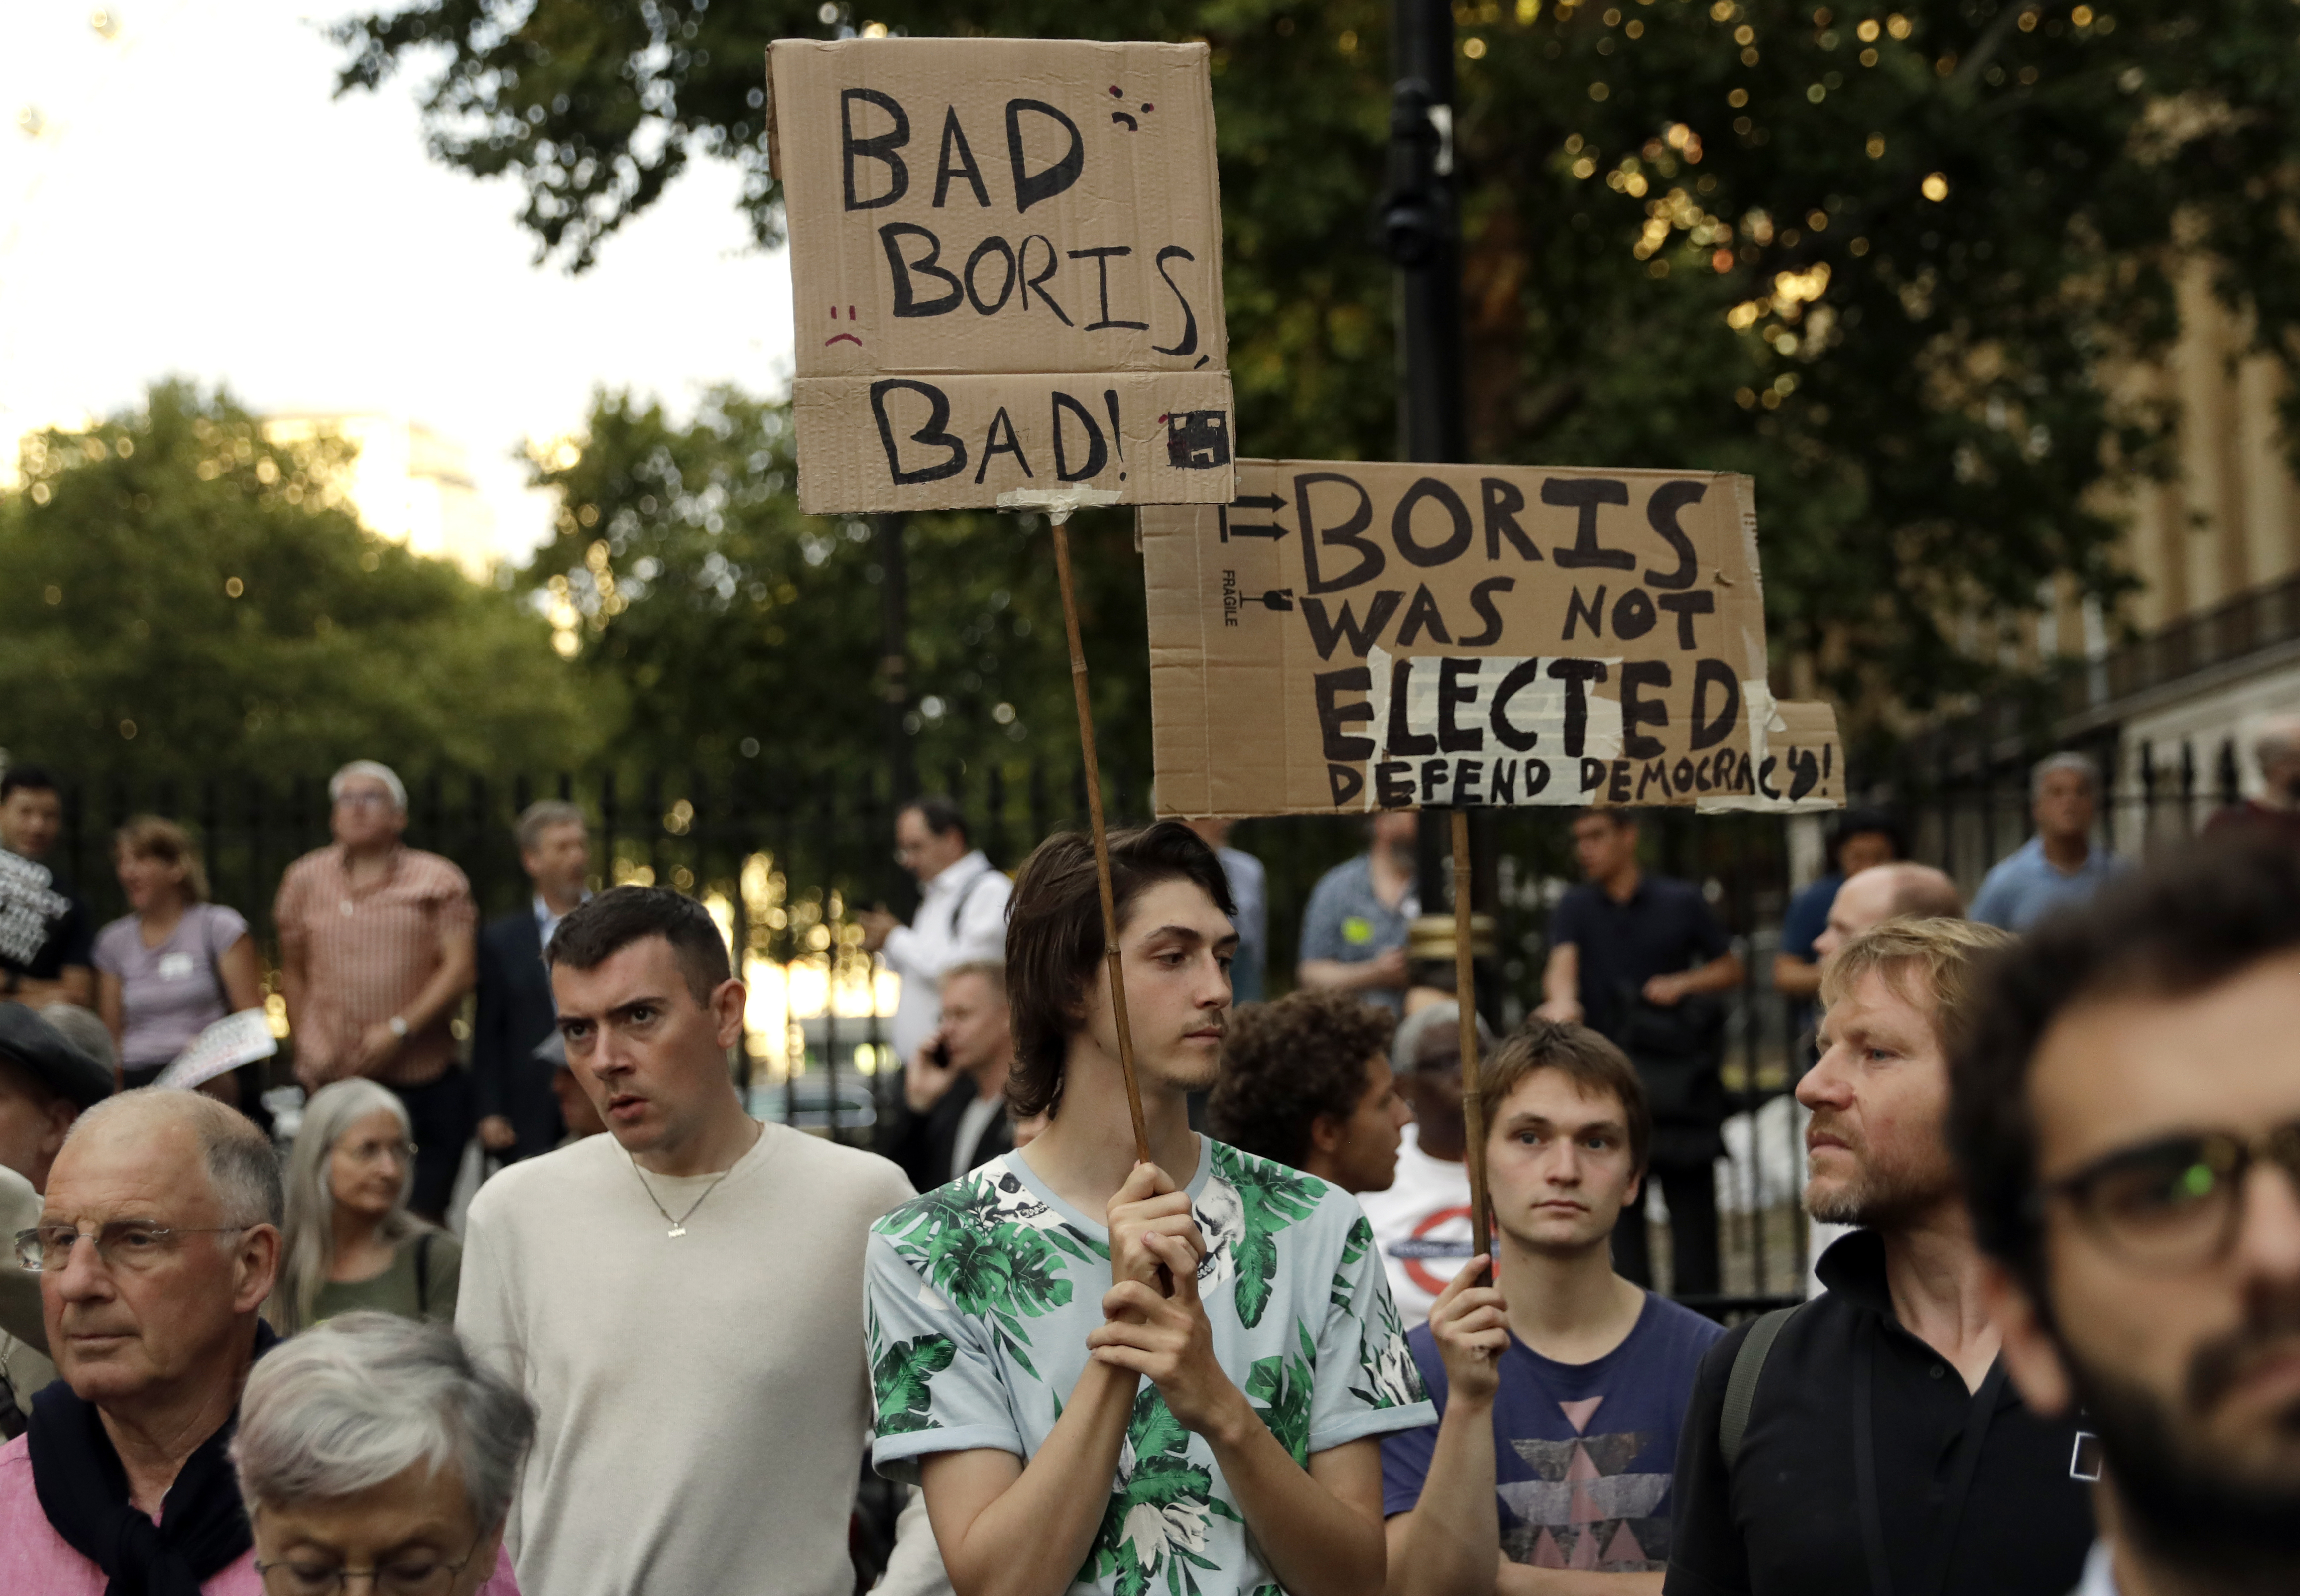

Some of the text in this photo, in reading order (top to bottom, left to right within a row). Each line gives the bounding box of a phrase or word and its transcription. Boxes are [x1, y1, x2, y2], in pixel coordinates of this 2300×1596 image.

[841, 88, 1084, 213] BAD
[870, 378, 1128, 486] BAD!
[1293, 473, 1709, 595] BORIS
[1222, 570, 1238, 626] FRAGILE
[1299, 576, 1714, 661] WAS NOT
[1314, 657, 1739, 761] ELECTED
[1328, 743, 1832, 810] DEFEND DEMOCRACY!
